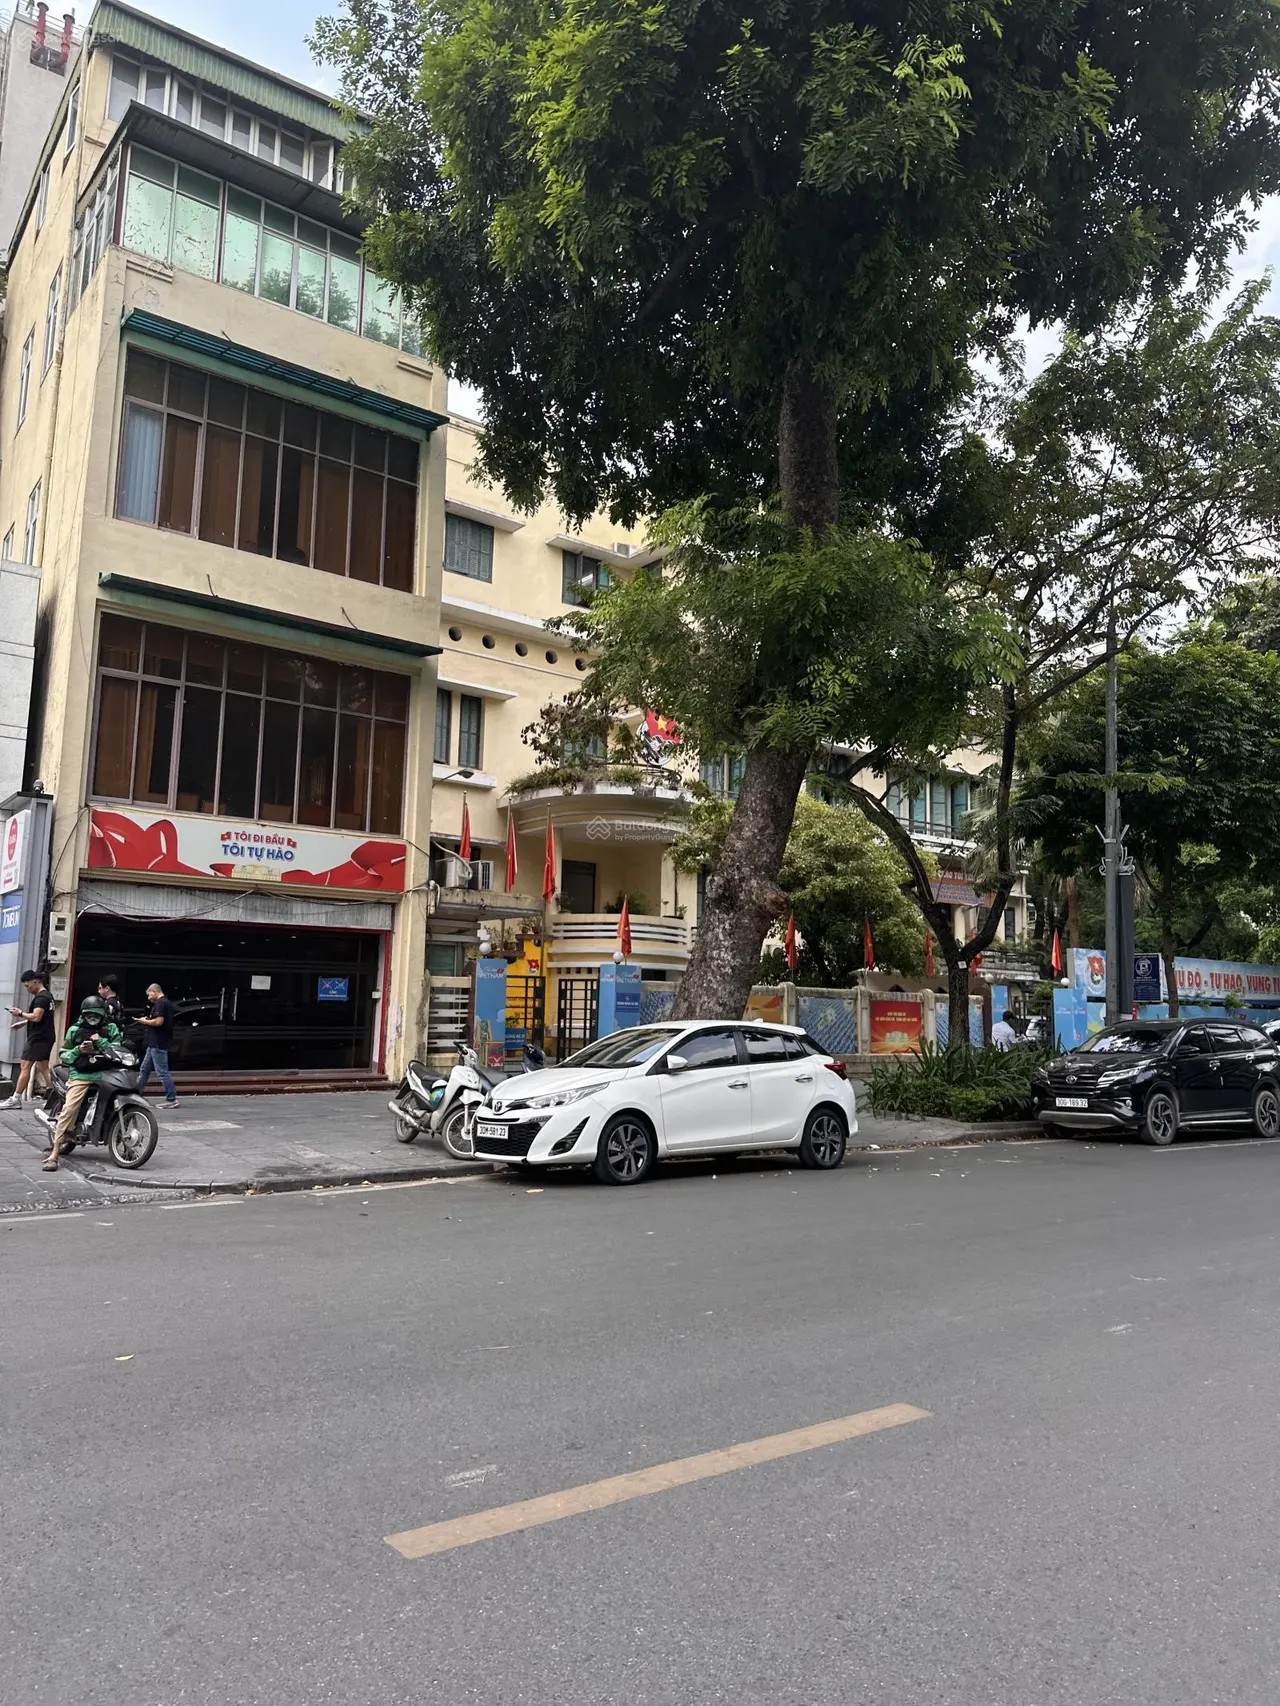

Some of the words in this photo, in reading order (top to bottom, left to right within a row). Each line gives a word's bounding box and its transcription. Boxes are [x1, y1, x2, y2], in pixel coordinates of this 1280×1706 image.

[234, 831, 251, 841] TÔI
[253, 834, 263, 843] ĐI
[266, 833, 285, 845] BẦU
[222, 843, 245, 857] TÔI
[247, 846, 265, 861] TỰ
[266, 847, 295, 861] HÀO
